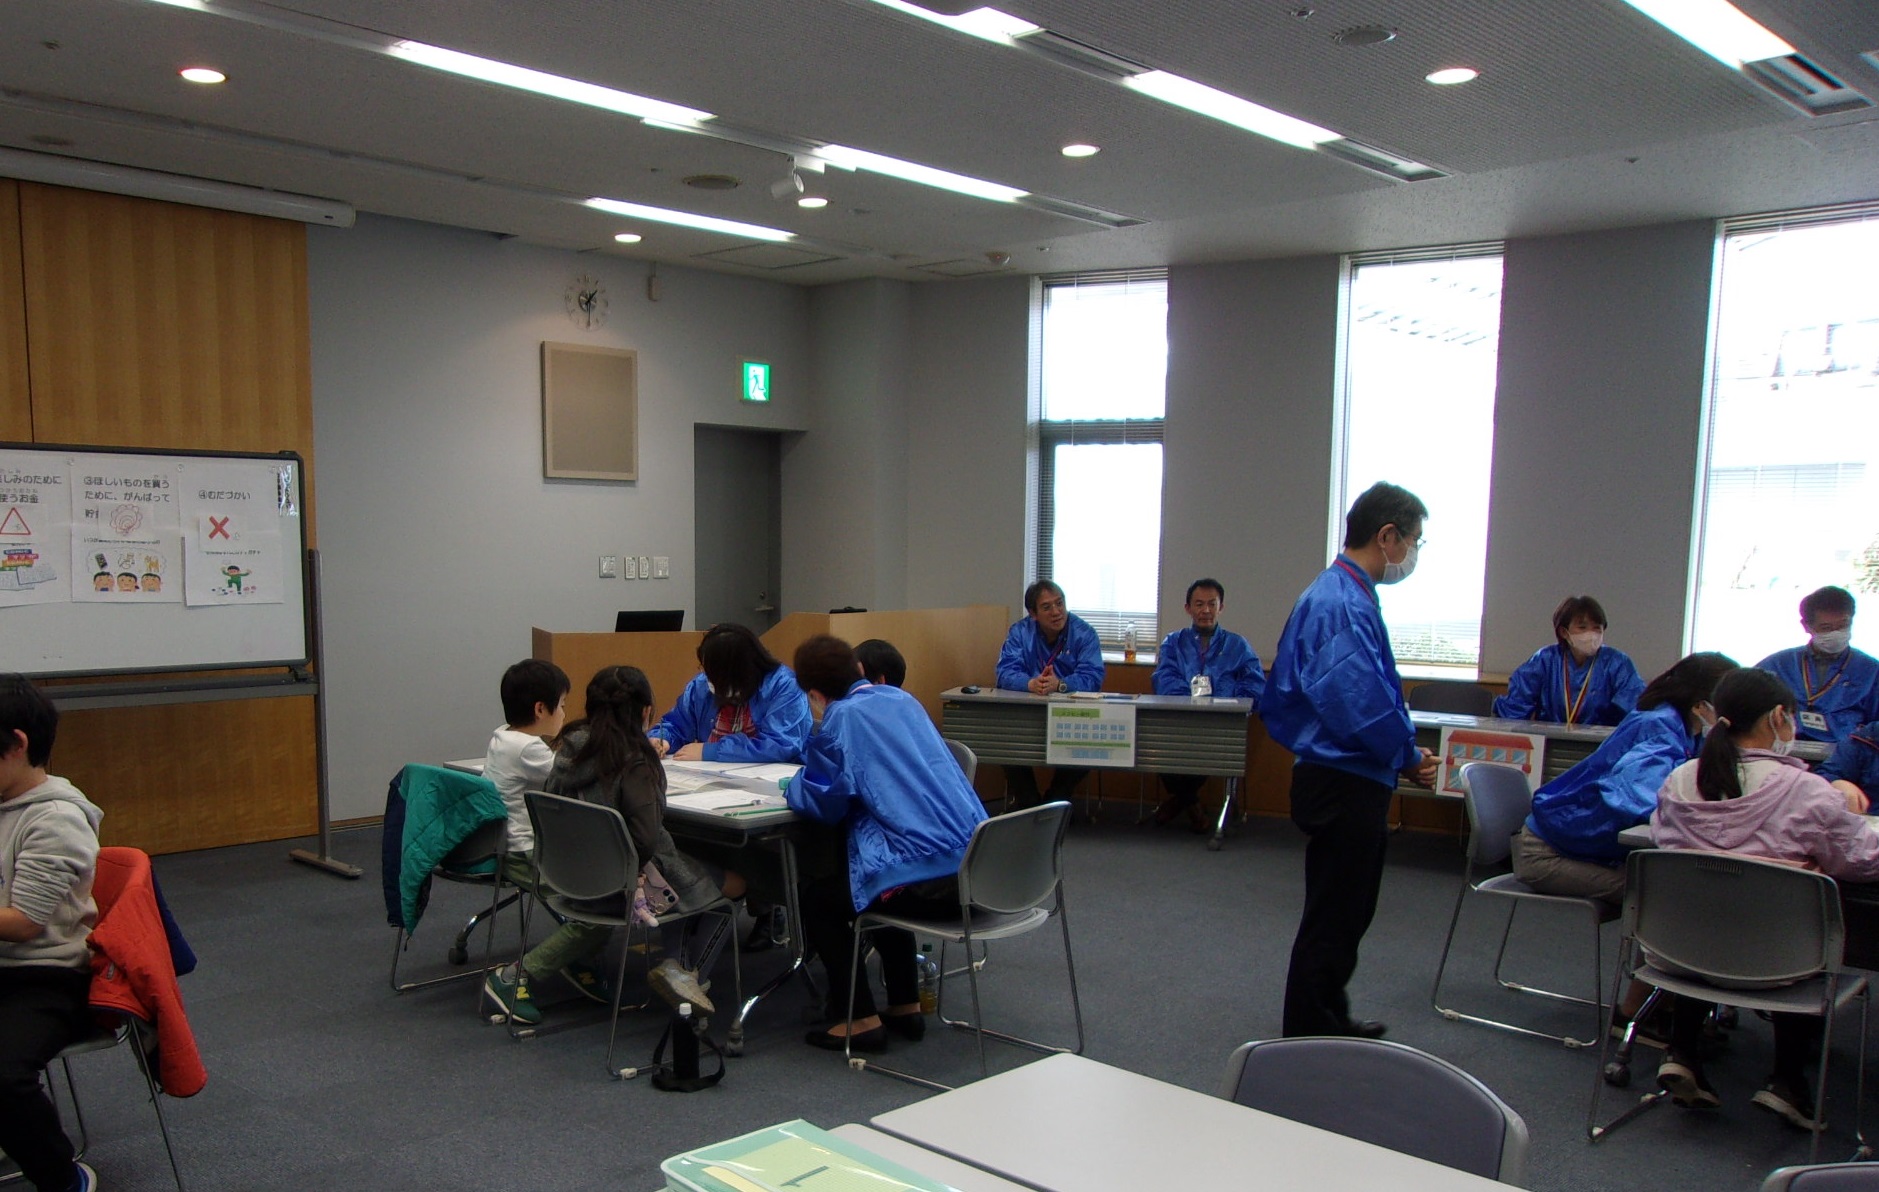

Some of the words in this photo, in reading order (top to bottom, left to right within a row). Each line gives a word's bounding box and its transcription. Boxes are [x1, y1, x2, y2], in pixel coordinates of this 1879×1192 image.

[0, 474, 63, 484] しみのために
[84, 490, 170, 503] ために、がんばって
[198, 489, 251, 500] ④むだづかい
